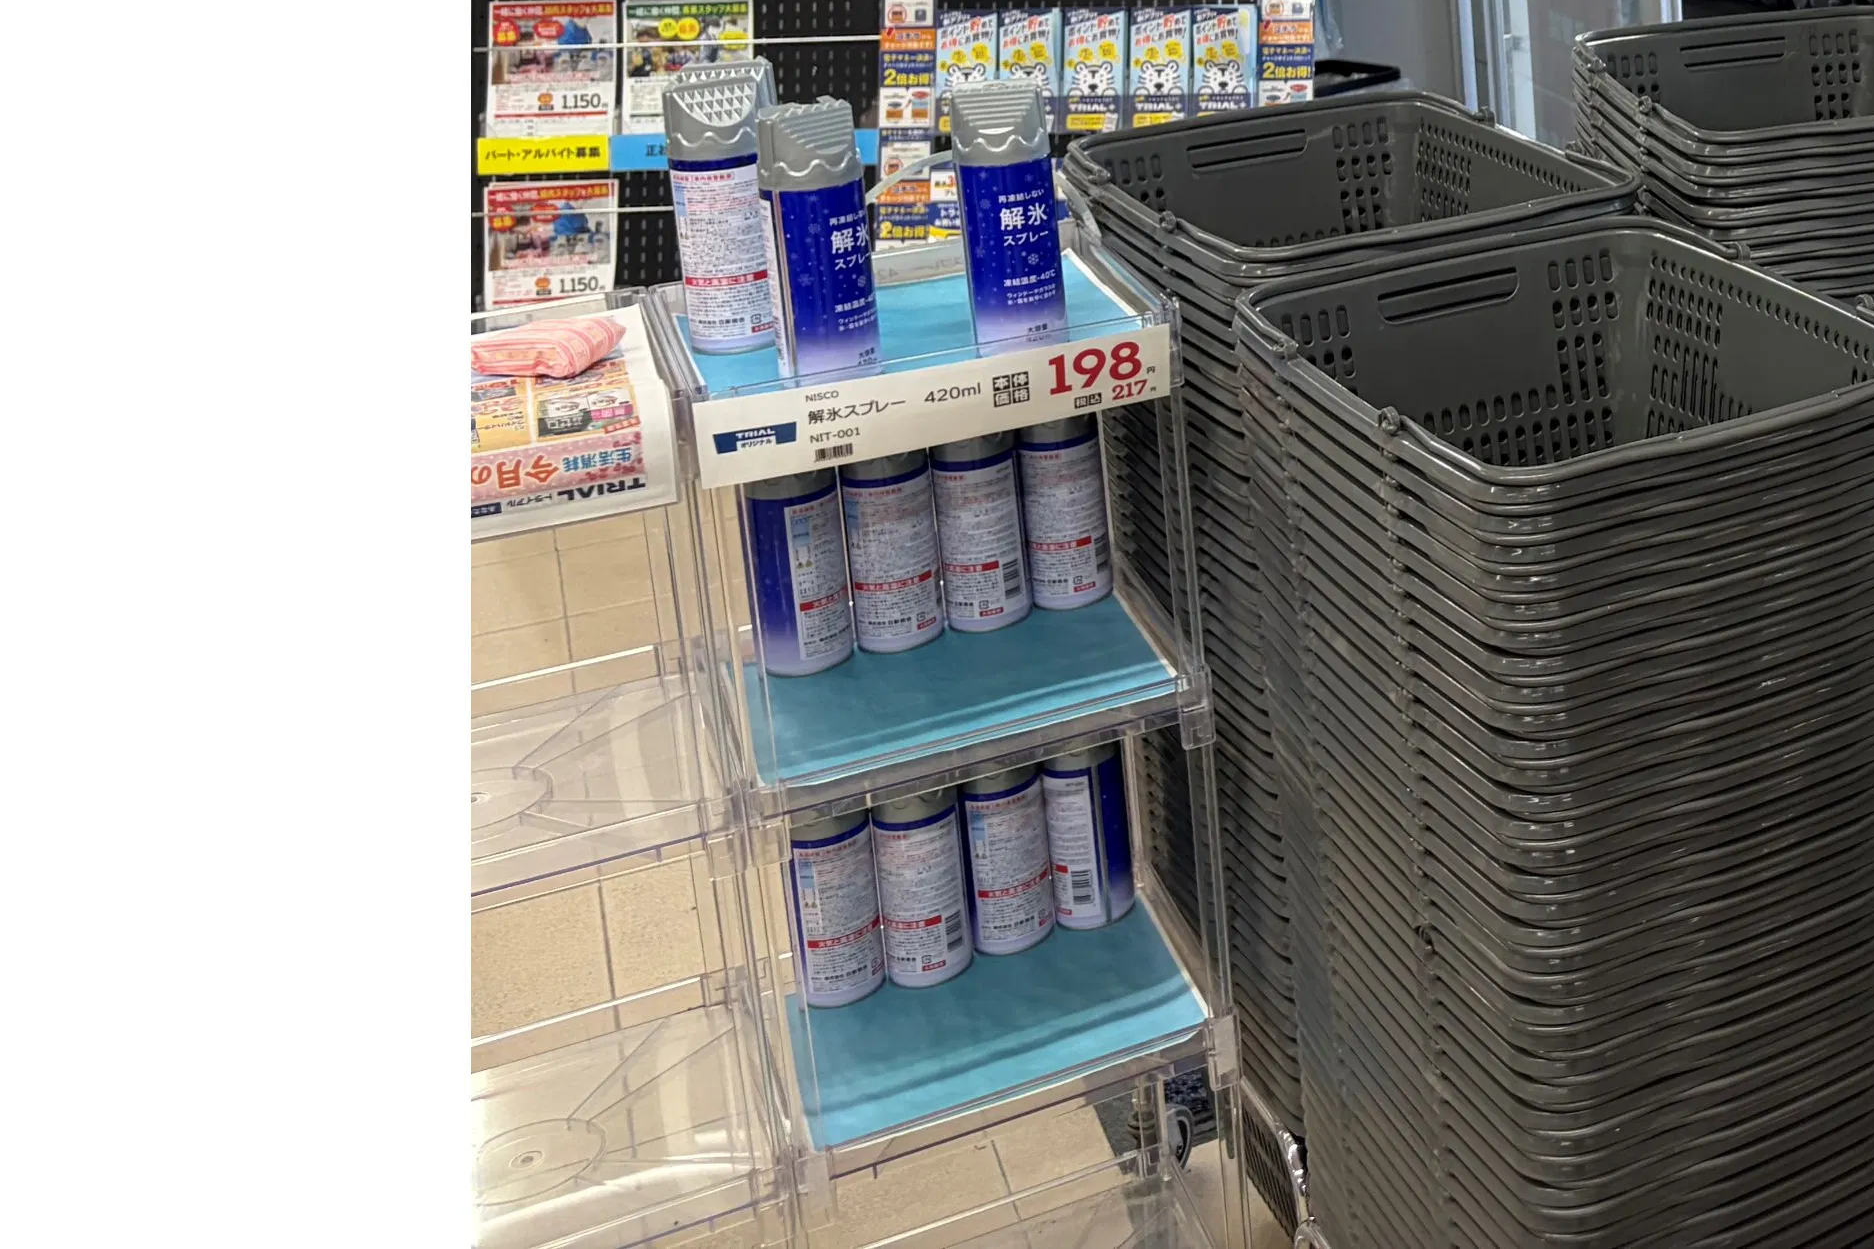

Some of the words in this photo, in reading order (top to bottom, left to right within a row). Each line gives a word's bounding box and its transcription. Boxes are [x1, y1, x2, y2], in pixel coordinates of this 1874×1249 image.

[485, 145, 602, 162] パート・アルバイト募集
[999, 202, 1048, 231] 解氷
[1003, 230, 1049, 247] スプレー
[804, 390, 840, 403] NISCO
[807, 399, 906, 425] 解氷スプレー
[923, 382, 981, 404] 420ml
[735, 427, 776, 440] TRIAL
[809, 427, 861, 444] NIT-001
[740, 439, 773, 449] オリジナル
[556, 477, 647, 502] TRIAL
